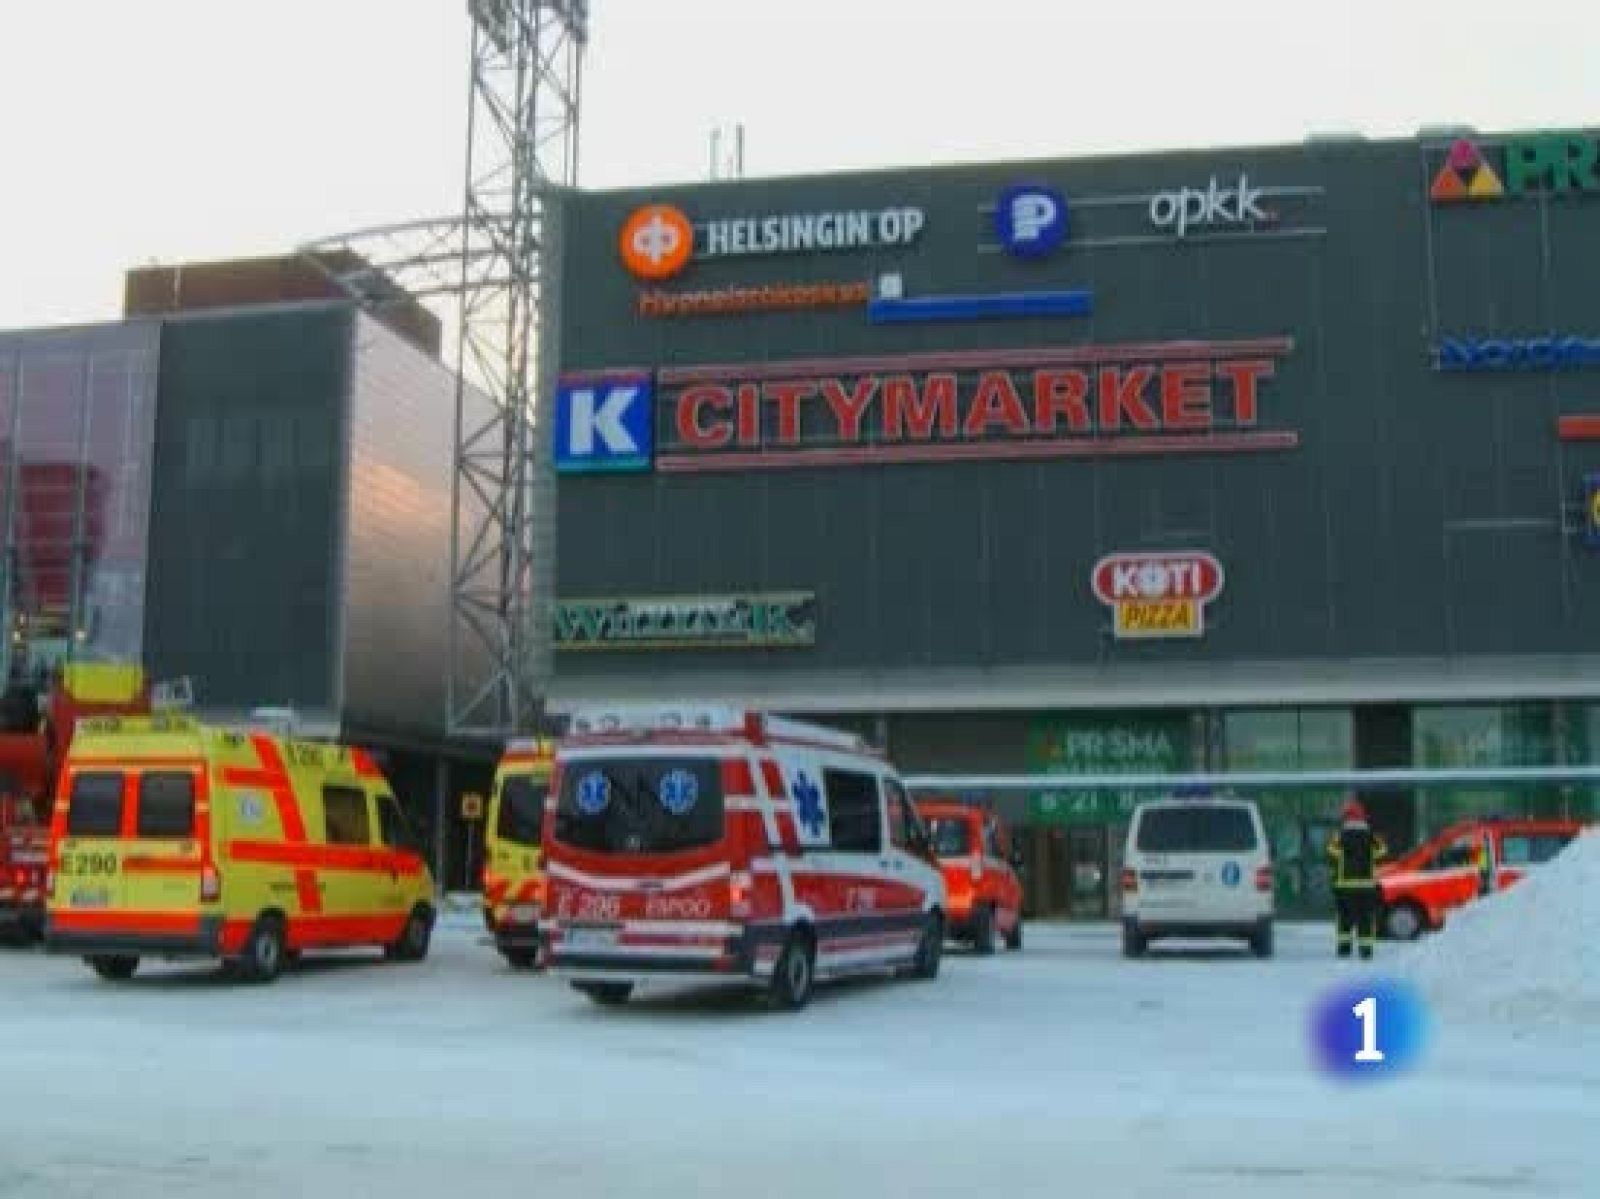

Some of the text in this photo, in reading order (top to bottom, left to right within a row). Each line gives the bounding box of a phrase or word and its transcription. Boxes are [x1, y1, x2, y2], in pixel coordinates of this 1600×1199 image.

[709, 207, 922, 254] HELSINGIN OP
[570, 360, 1275, 455] K CITYMARKET
[1113, 560, 1200, 598] KOTI
[1124, 603, 1189, 629] PIZZA
